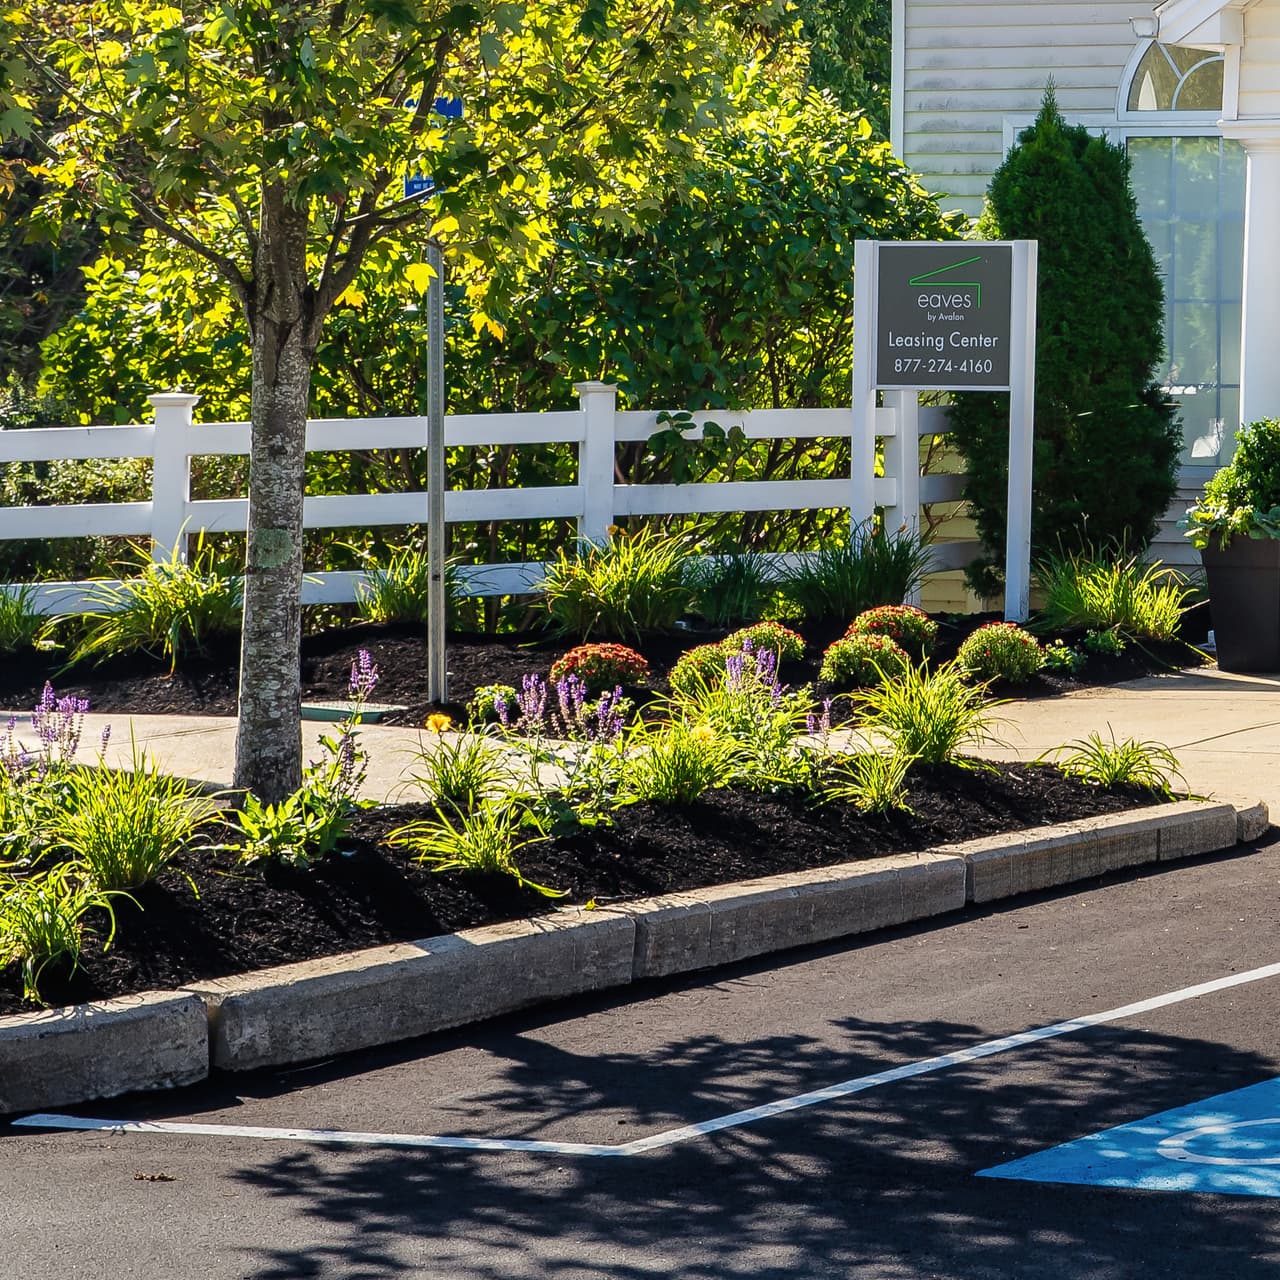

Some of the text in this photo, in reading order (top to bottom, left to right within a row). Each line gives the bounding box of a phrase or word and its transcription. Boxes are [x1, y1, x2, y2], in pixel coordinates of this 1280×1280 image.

[917, 291, 972, 308] eaves
[927, 311, 965, 323] by Avalon
[889, 331, 999, 352] Leasing Center
[894, 358, 993, 374] 877-274-4160
